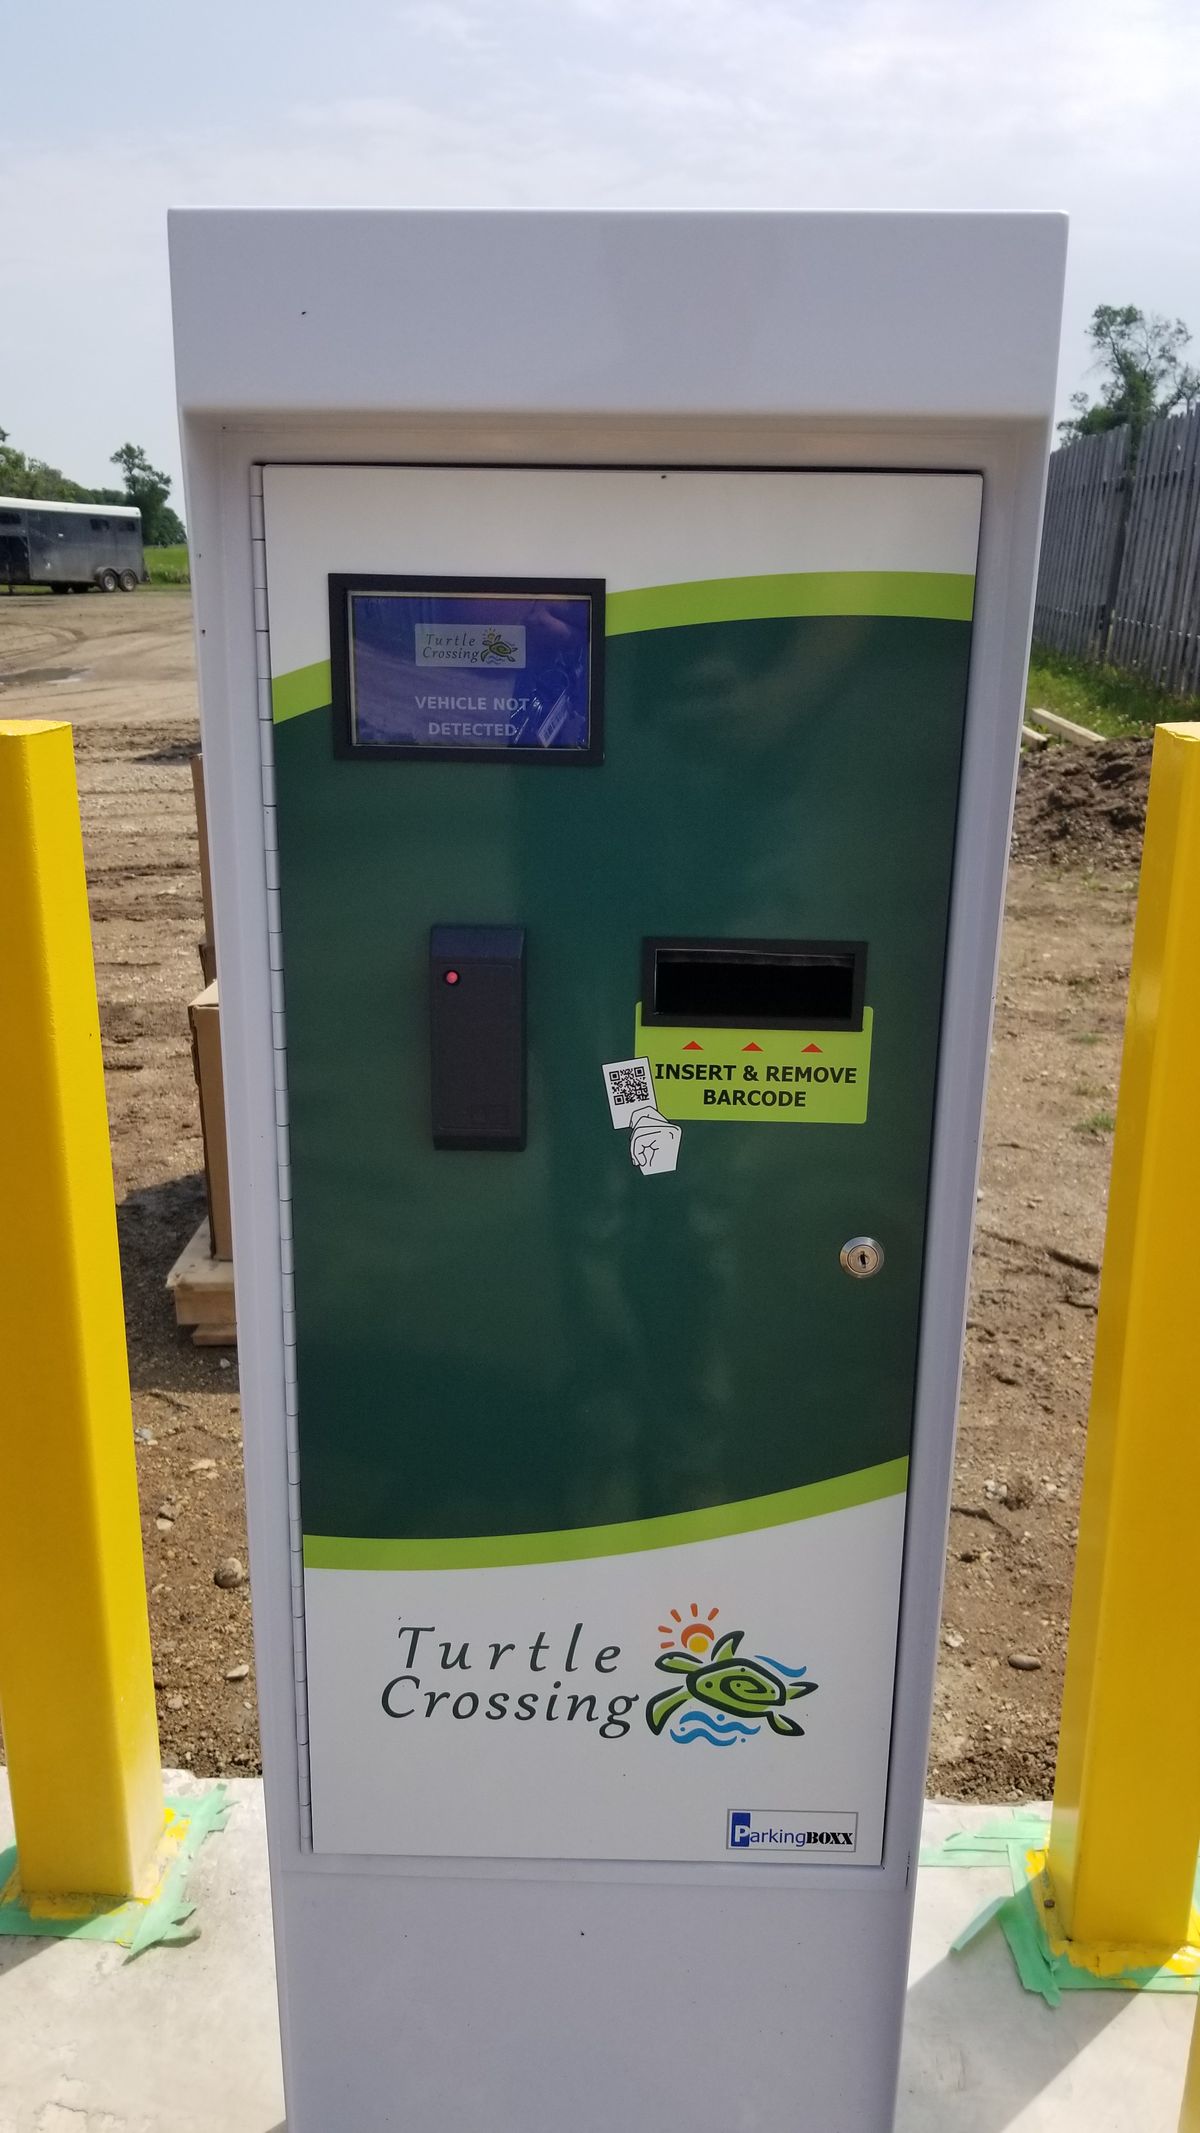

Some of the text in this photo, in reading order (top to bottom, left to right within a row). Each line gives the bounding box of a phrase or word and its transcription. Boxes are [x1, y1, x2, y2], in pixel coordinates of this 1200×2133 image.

[426, 633, 476, 646] Turtle
[423, 646, 480, 663] Crossing
[415, 696, 529, 711] VEHICLE NOT
[429, 723, 516, 736] DETECTED
[655, 1064, 857, 1084] INSERT & REMOVE
[703, 1089, 806, 1107] BARCODE
[399, 1622, 621, 1673] Turtle
[381, 1675, 640, 1738] Crossing
